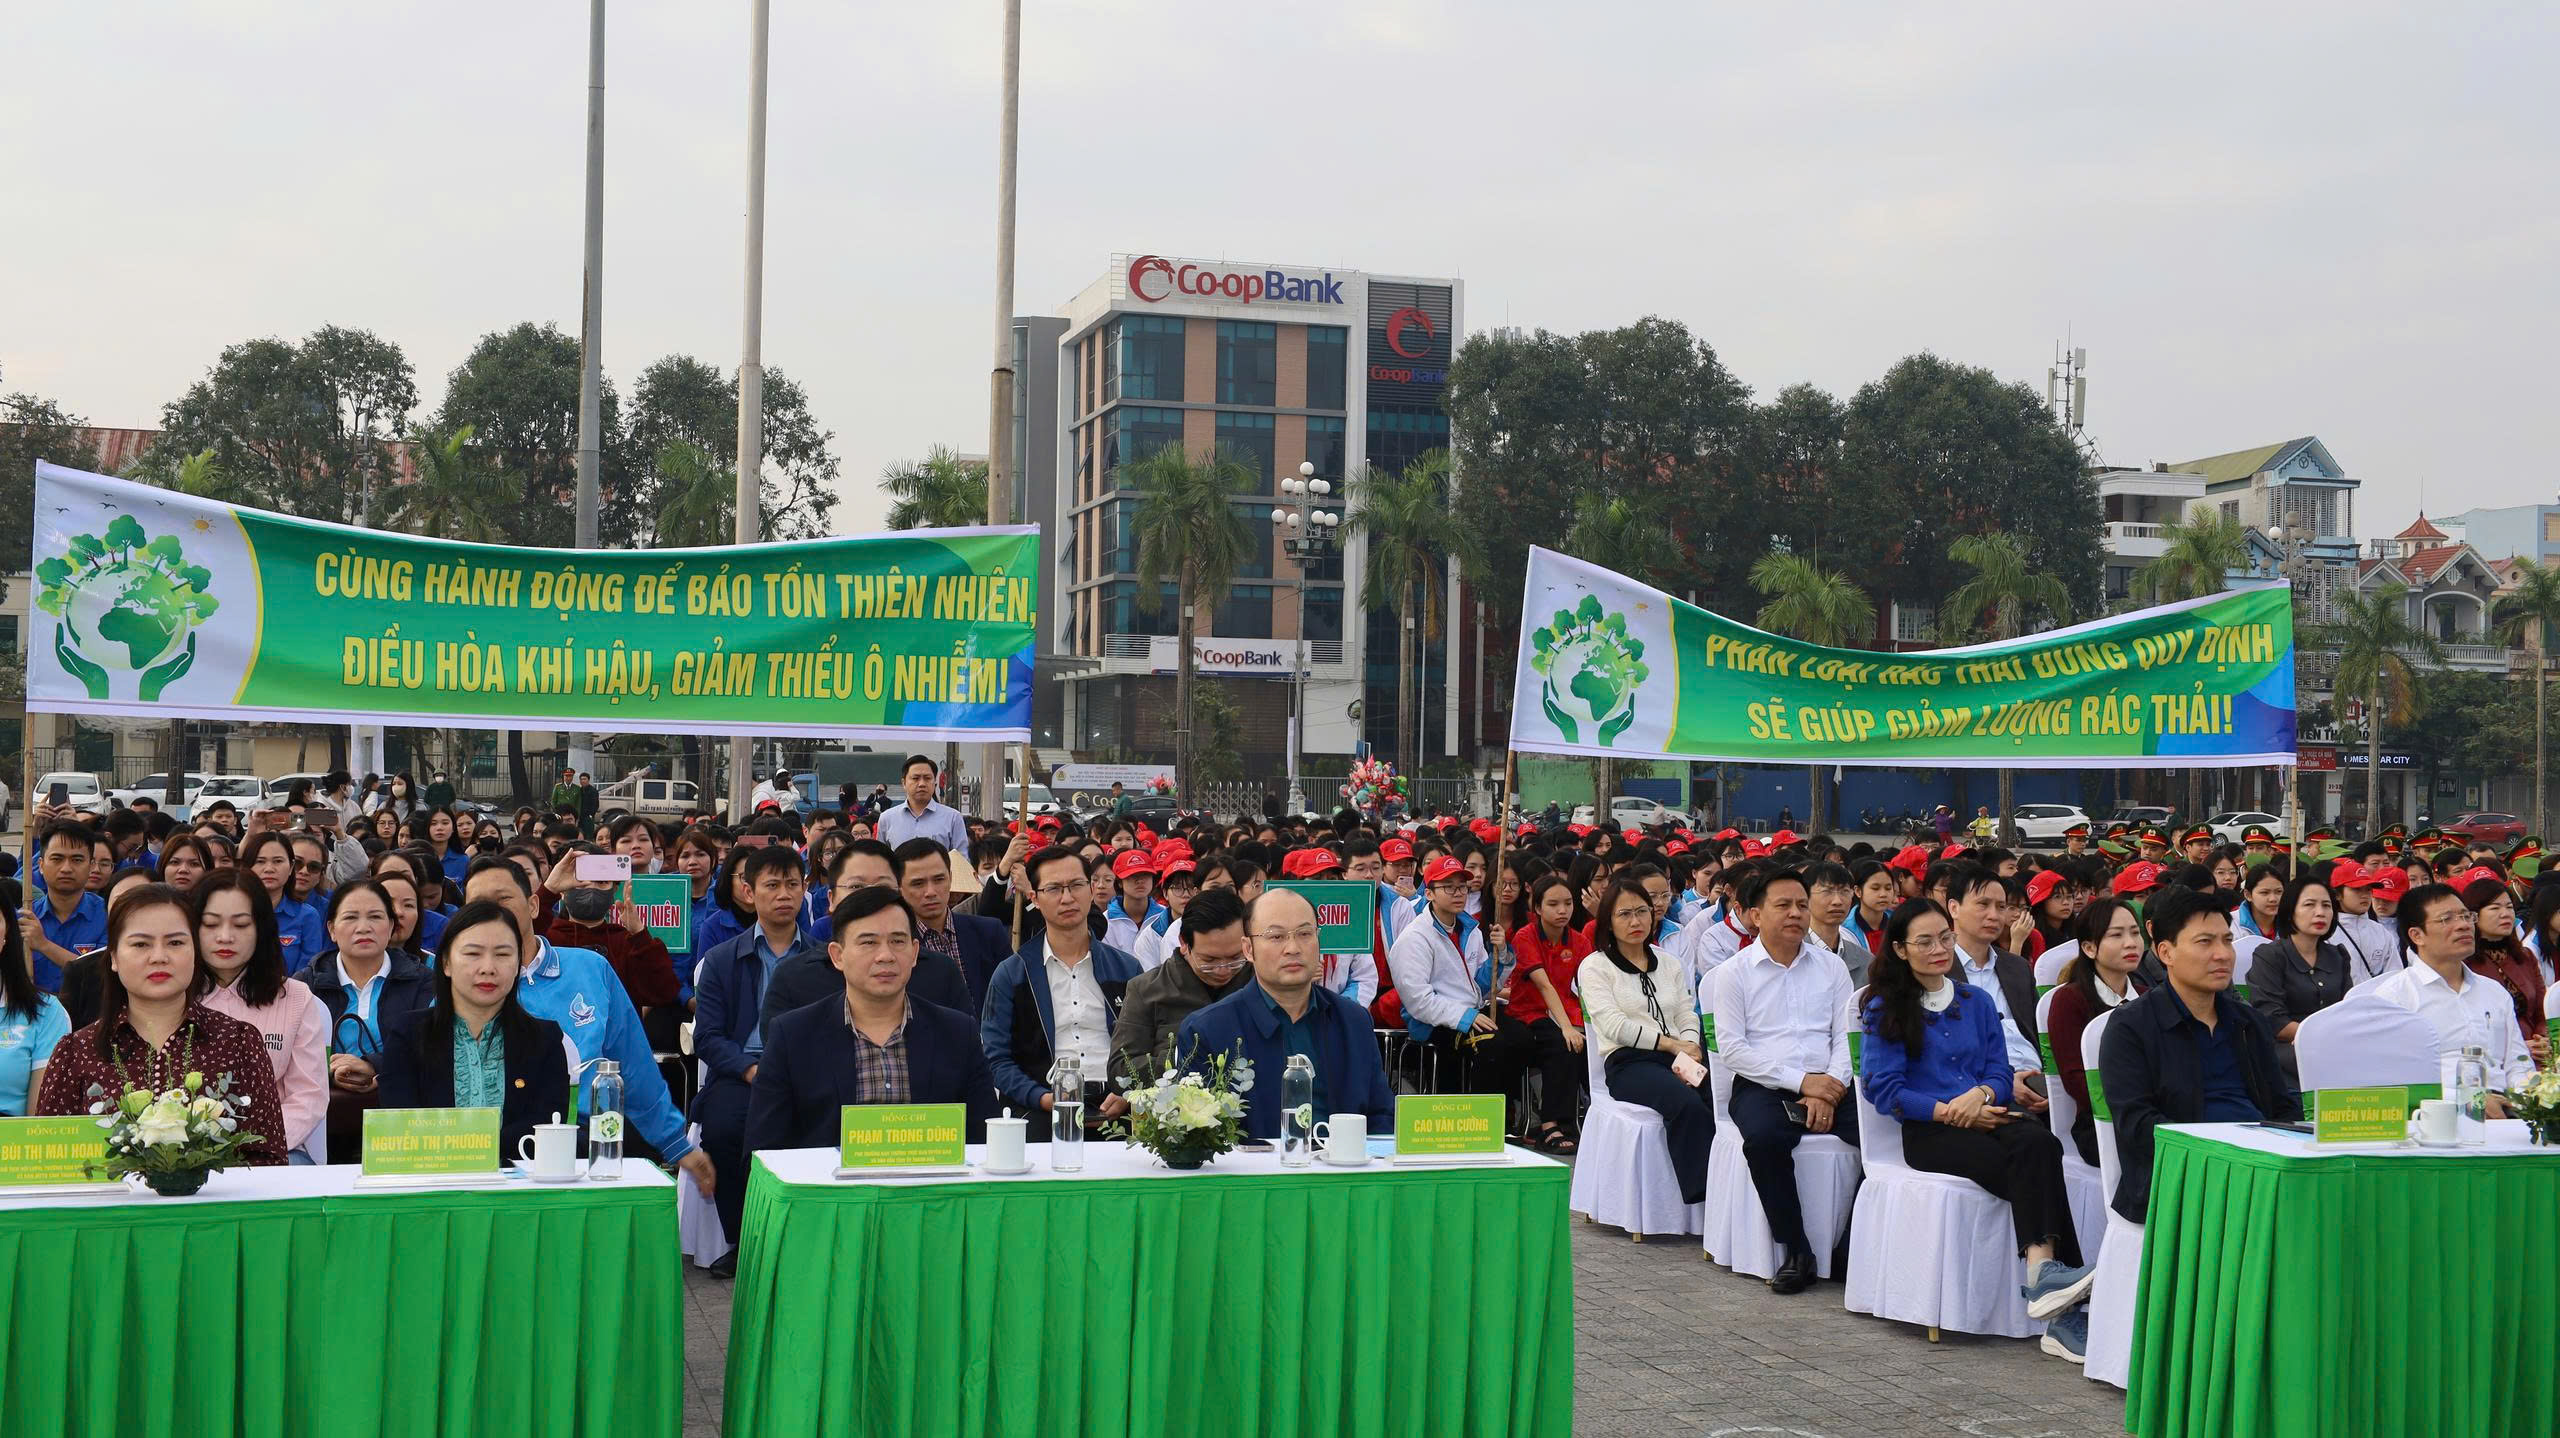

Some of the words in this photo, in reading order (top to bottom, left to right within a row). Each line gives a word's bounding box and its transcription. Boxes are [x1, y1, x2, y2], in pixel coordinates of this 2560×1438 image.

[315, 546, 414, 601] CÙNG
[424, 558, 522, 608] HÀNH
[530, 565, 625, 621] ĐỘNG
[633, 561, 684, 615] ĐỂ
[686, 563, 752, 617] BẢO
[763, 562, 826, 618] TỒN
[835, 565, 928, 619] THIÊN
[933, 566, 1037, 630] NHIÊN,
[342, 622, 424, 689] ĐIỀU
[435, 630, 506, 693] HÒA
[516, 637, 575, 695] KHÍ
[583, 639, 660, 705] HẬU,
[671, 635, 757, 697] GIẢM
[767, 634, 854, 700] THIỂU
[863, 643, 884, 701] Ô
[893, 639, 1008, 704] NHIỄM!
[1705, 633, 1798, 677] PHÂN
[1799, 656, 1882, 691] LOẠI
[2132, 628, 2194, 671] QUY
[2197, 623, 2274, 673] ĐỊNH
[1747, 696, 1792, 741] SẼ
[1797, 701, 1876, 743] GIÚP
[1885, 698, 1972, 741] GIẢM
[1971, 699, 2073, 745] LƯỢNG
[2080, 686, 2142, 735] RÁC
[2150, 680, 2233, 735] THẢI!
[2393, 756, 2411, 764] CITY
[651, 899, 681, 928] NIÊN
[1317, 904, 1350, 926] SINH
[1414, 1119, 1433, 1133] CAO
[1435, 1116, 1455, 1133] VĂN
[1457, 1115, 1489, 1132] CƯỜNG
[371, 1129, 419, 1152] NGUYỄN
[423, 1135, 440, 1153] THỊ
[848, 1128, 883, 1146] PHẠM
[885, 1127, 924, 1146] TRỌNG
[24, 1144, 42, 1163] THỊ
[46, 1143, 68, 1160] MAI
[71, 1142, 104, 1159] HOAN
